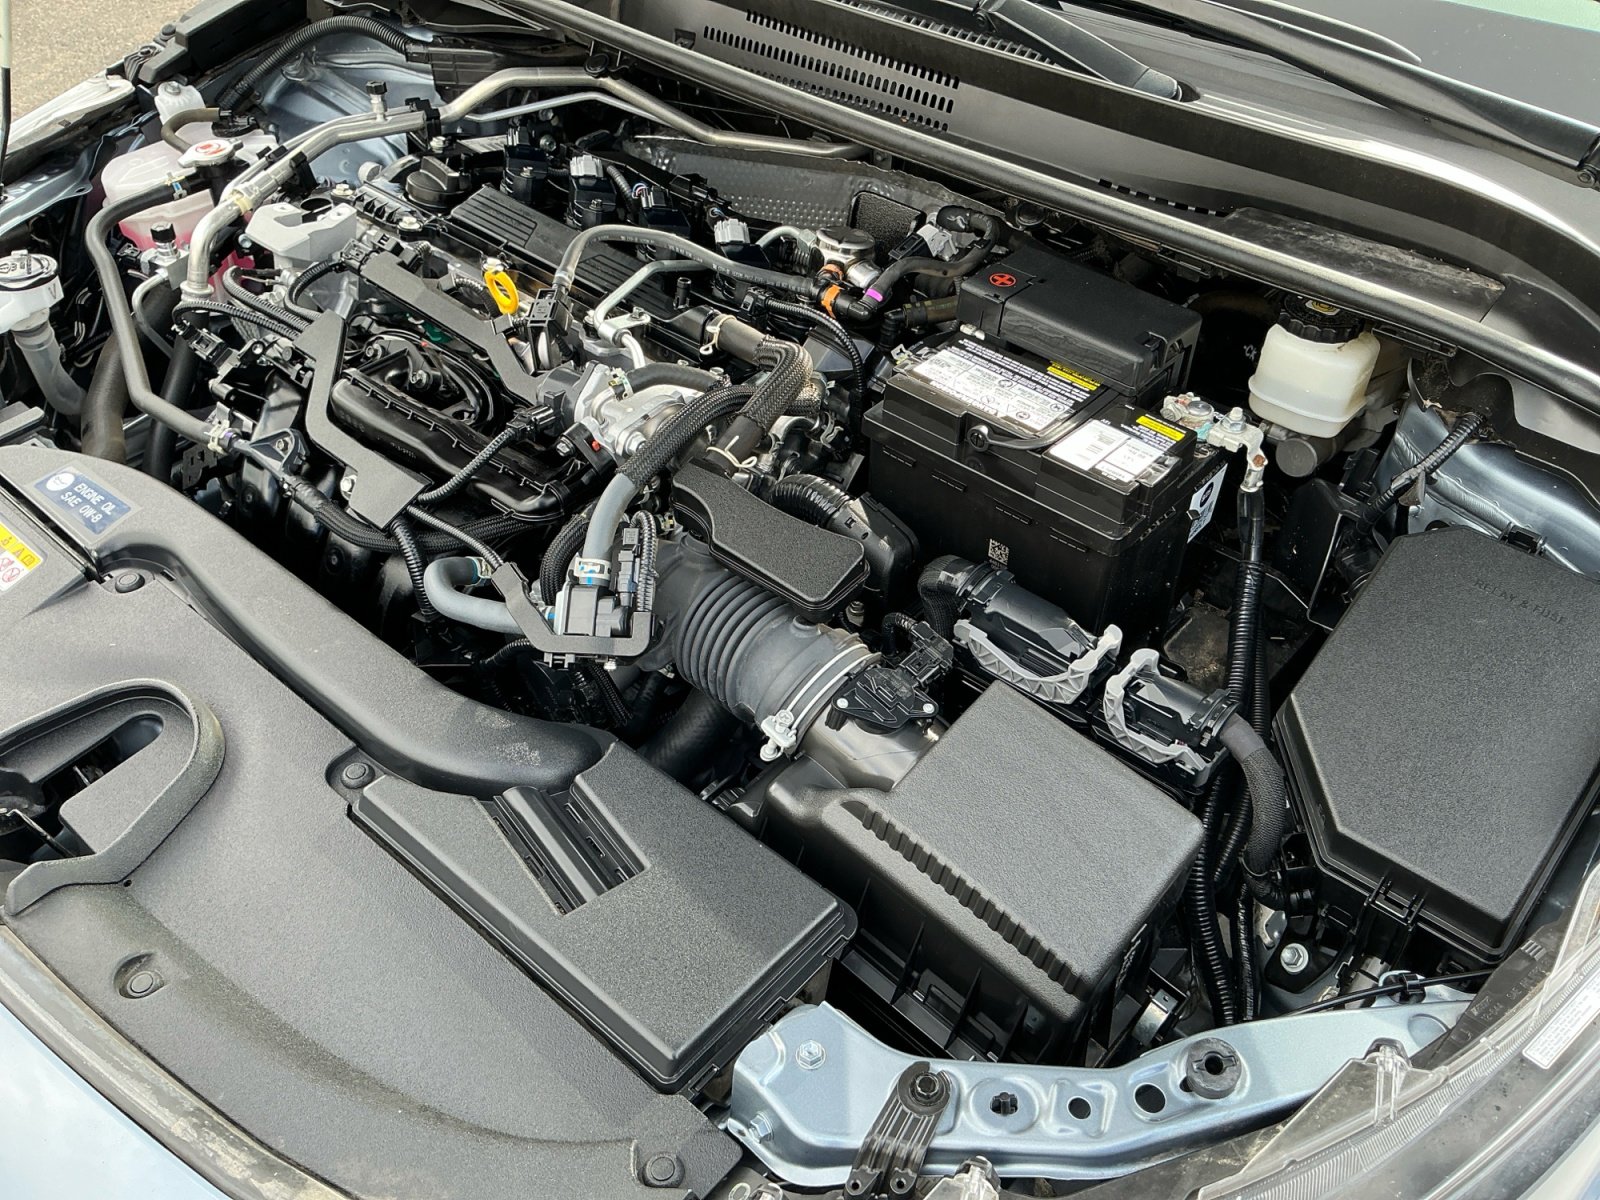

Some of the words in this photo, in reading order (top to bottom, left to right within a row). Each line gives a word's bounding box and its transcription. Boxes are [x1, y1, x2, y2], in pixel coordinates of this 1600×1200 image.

[61, 491, 82, 508] SAE
[79, 504, 103, 523] 0W-8
[74, 482, 104, 505] ENGINE
[101, 501, 116, 515] OIL
[1473, 578, 1517, 601] RELAY
[1532, 604, 1569, 625] FUSE
